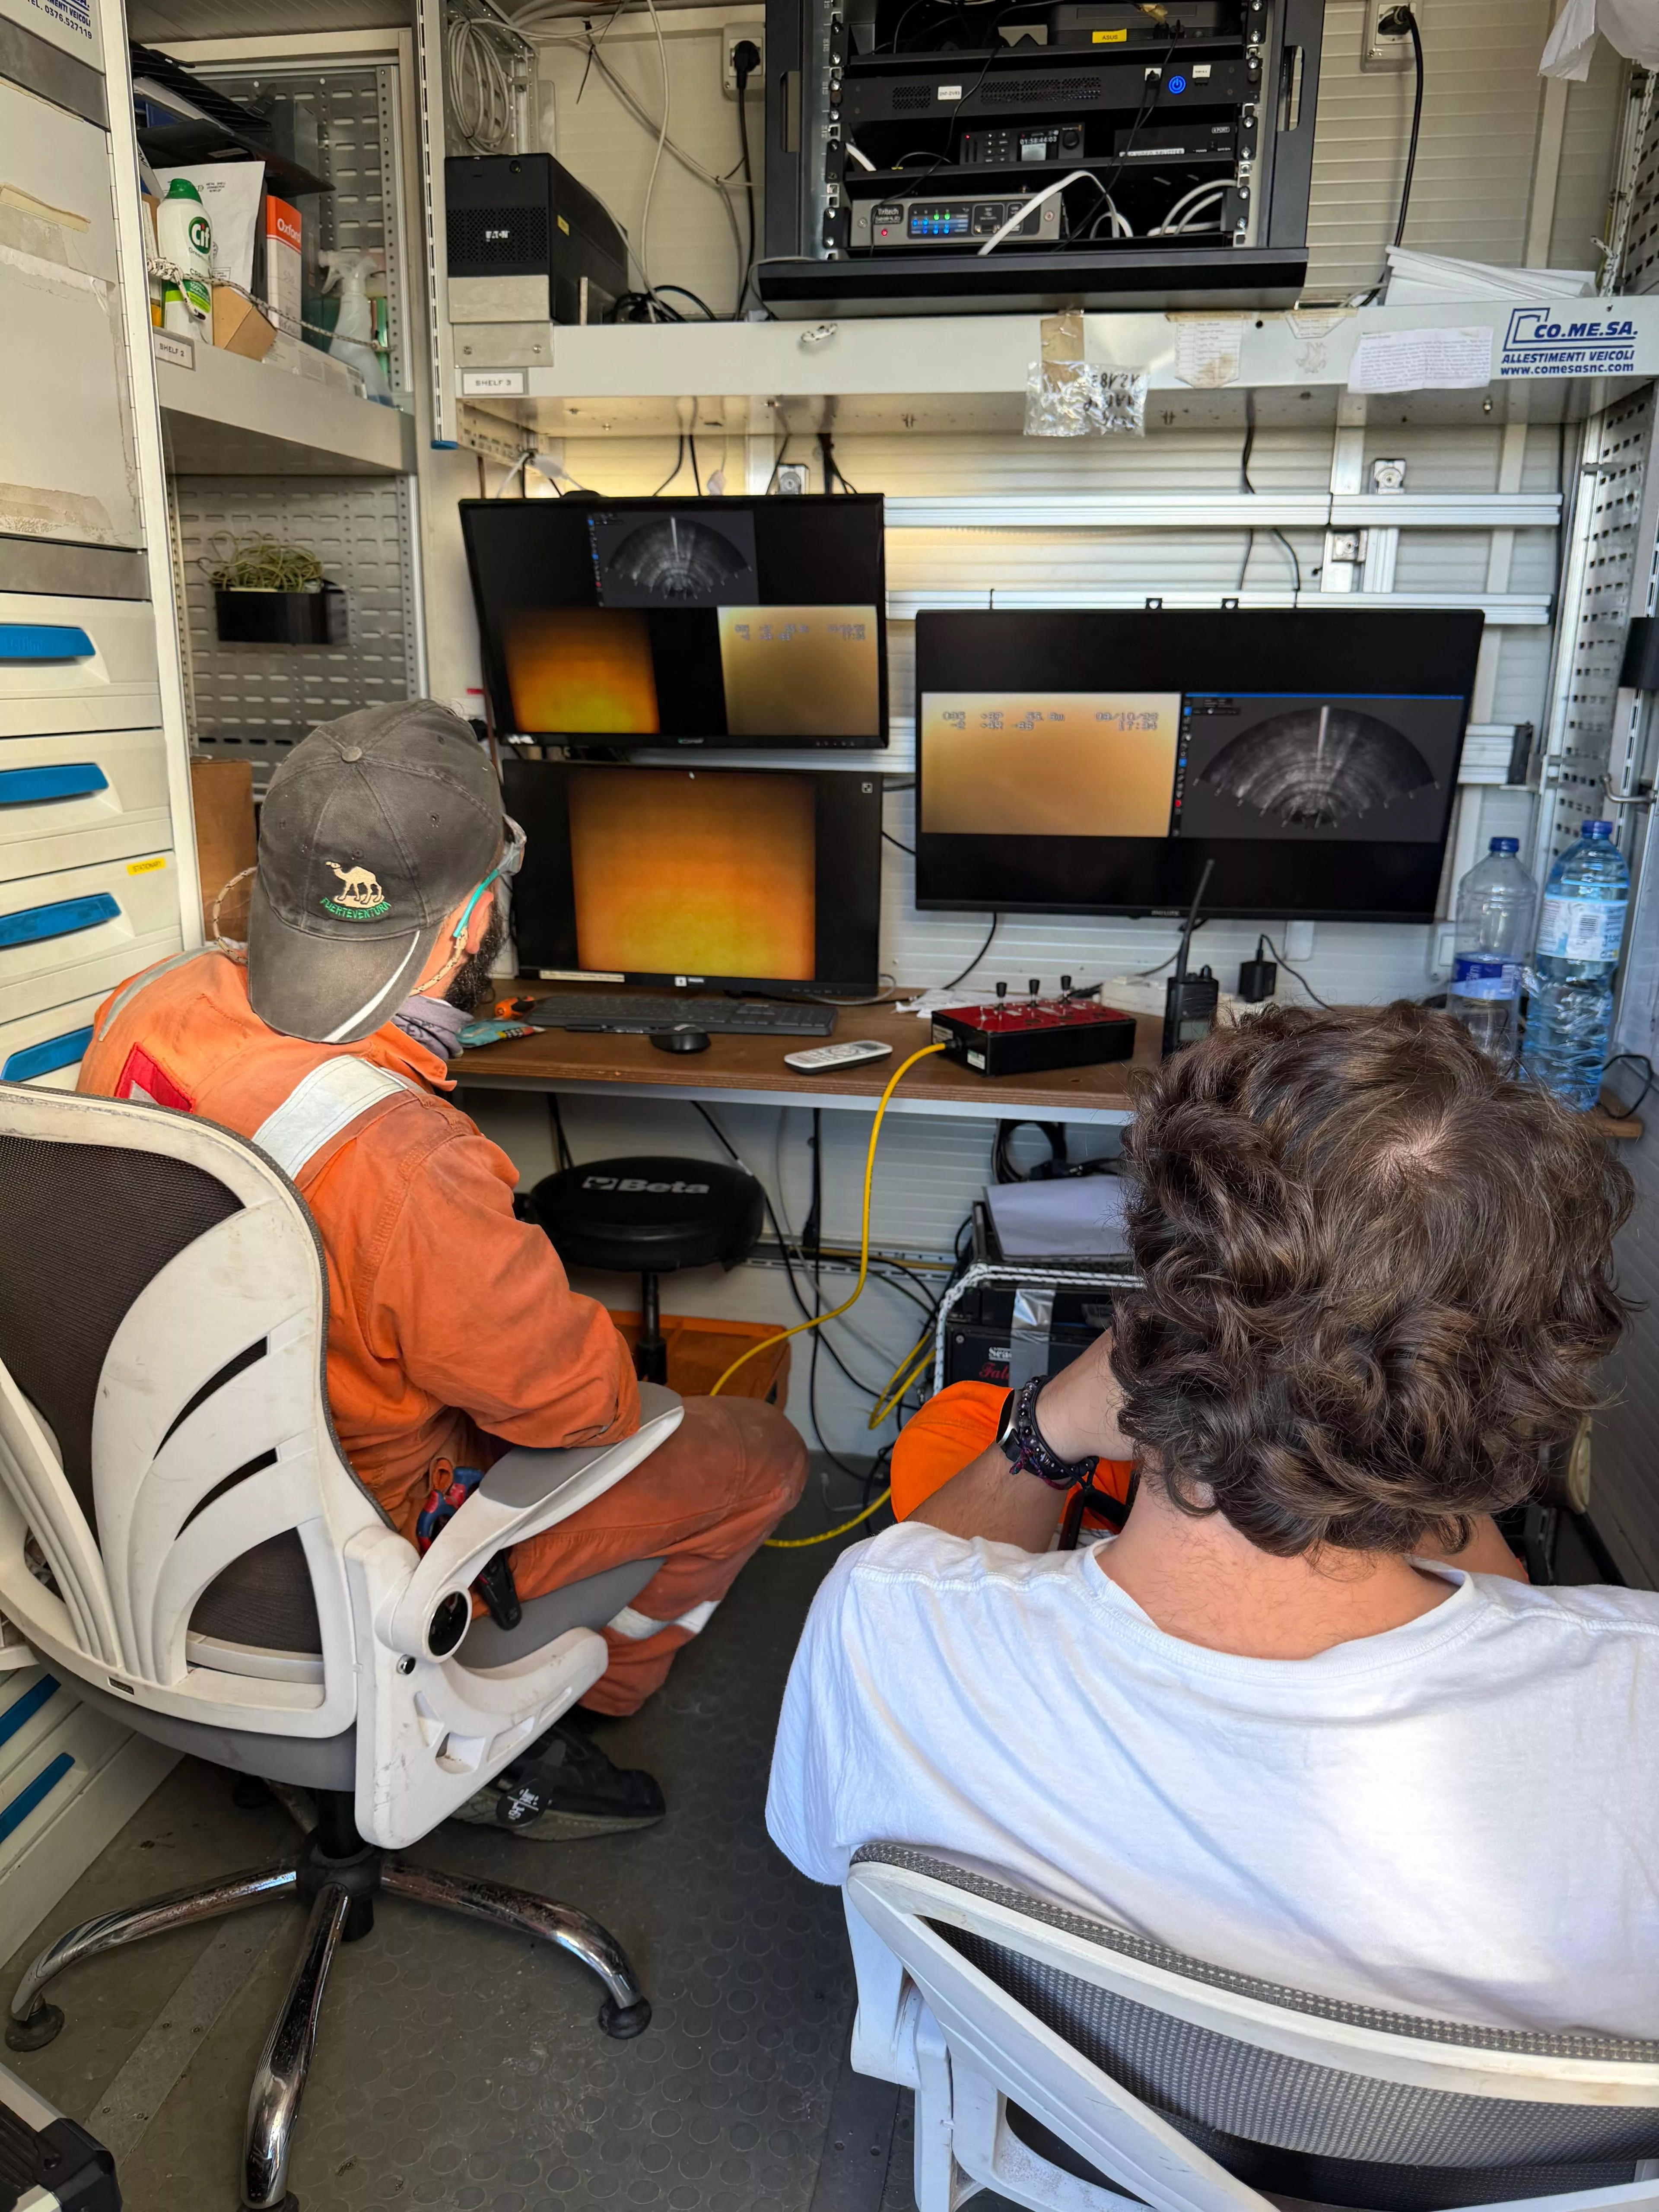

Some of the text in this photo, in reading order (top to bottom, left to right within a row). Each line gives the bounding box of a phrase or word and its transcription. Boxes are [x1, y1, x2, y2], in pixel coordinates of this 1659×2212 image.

[44, 5, 92, 39] 0376.527119
[69, 7, 91, 27] VEICOLI
[191, 222, 210, 248] Cif
[1534, 321, 1638, 338] CO.ME.SA.
[159, 343, 179, 355] SHELF
[1501, 350, 1635, 364] ALLESTIMENTI VEICOLI
[1500, 363, 1634, 375] www.comesasnc.com
[319, 897, 391, 920] FUERTEVENTURA
[618, 1178, 710, 1194] Beta
